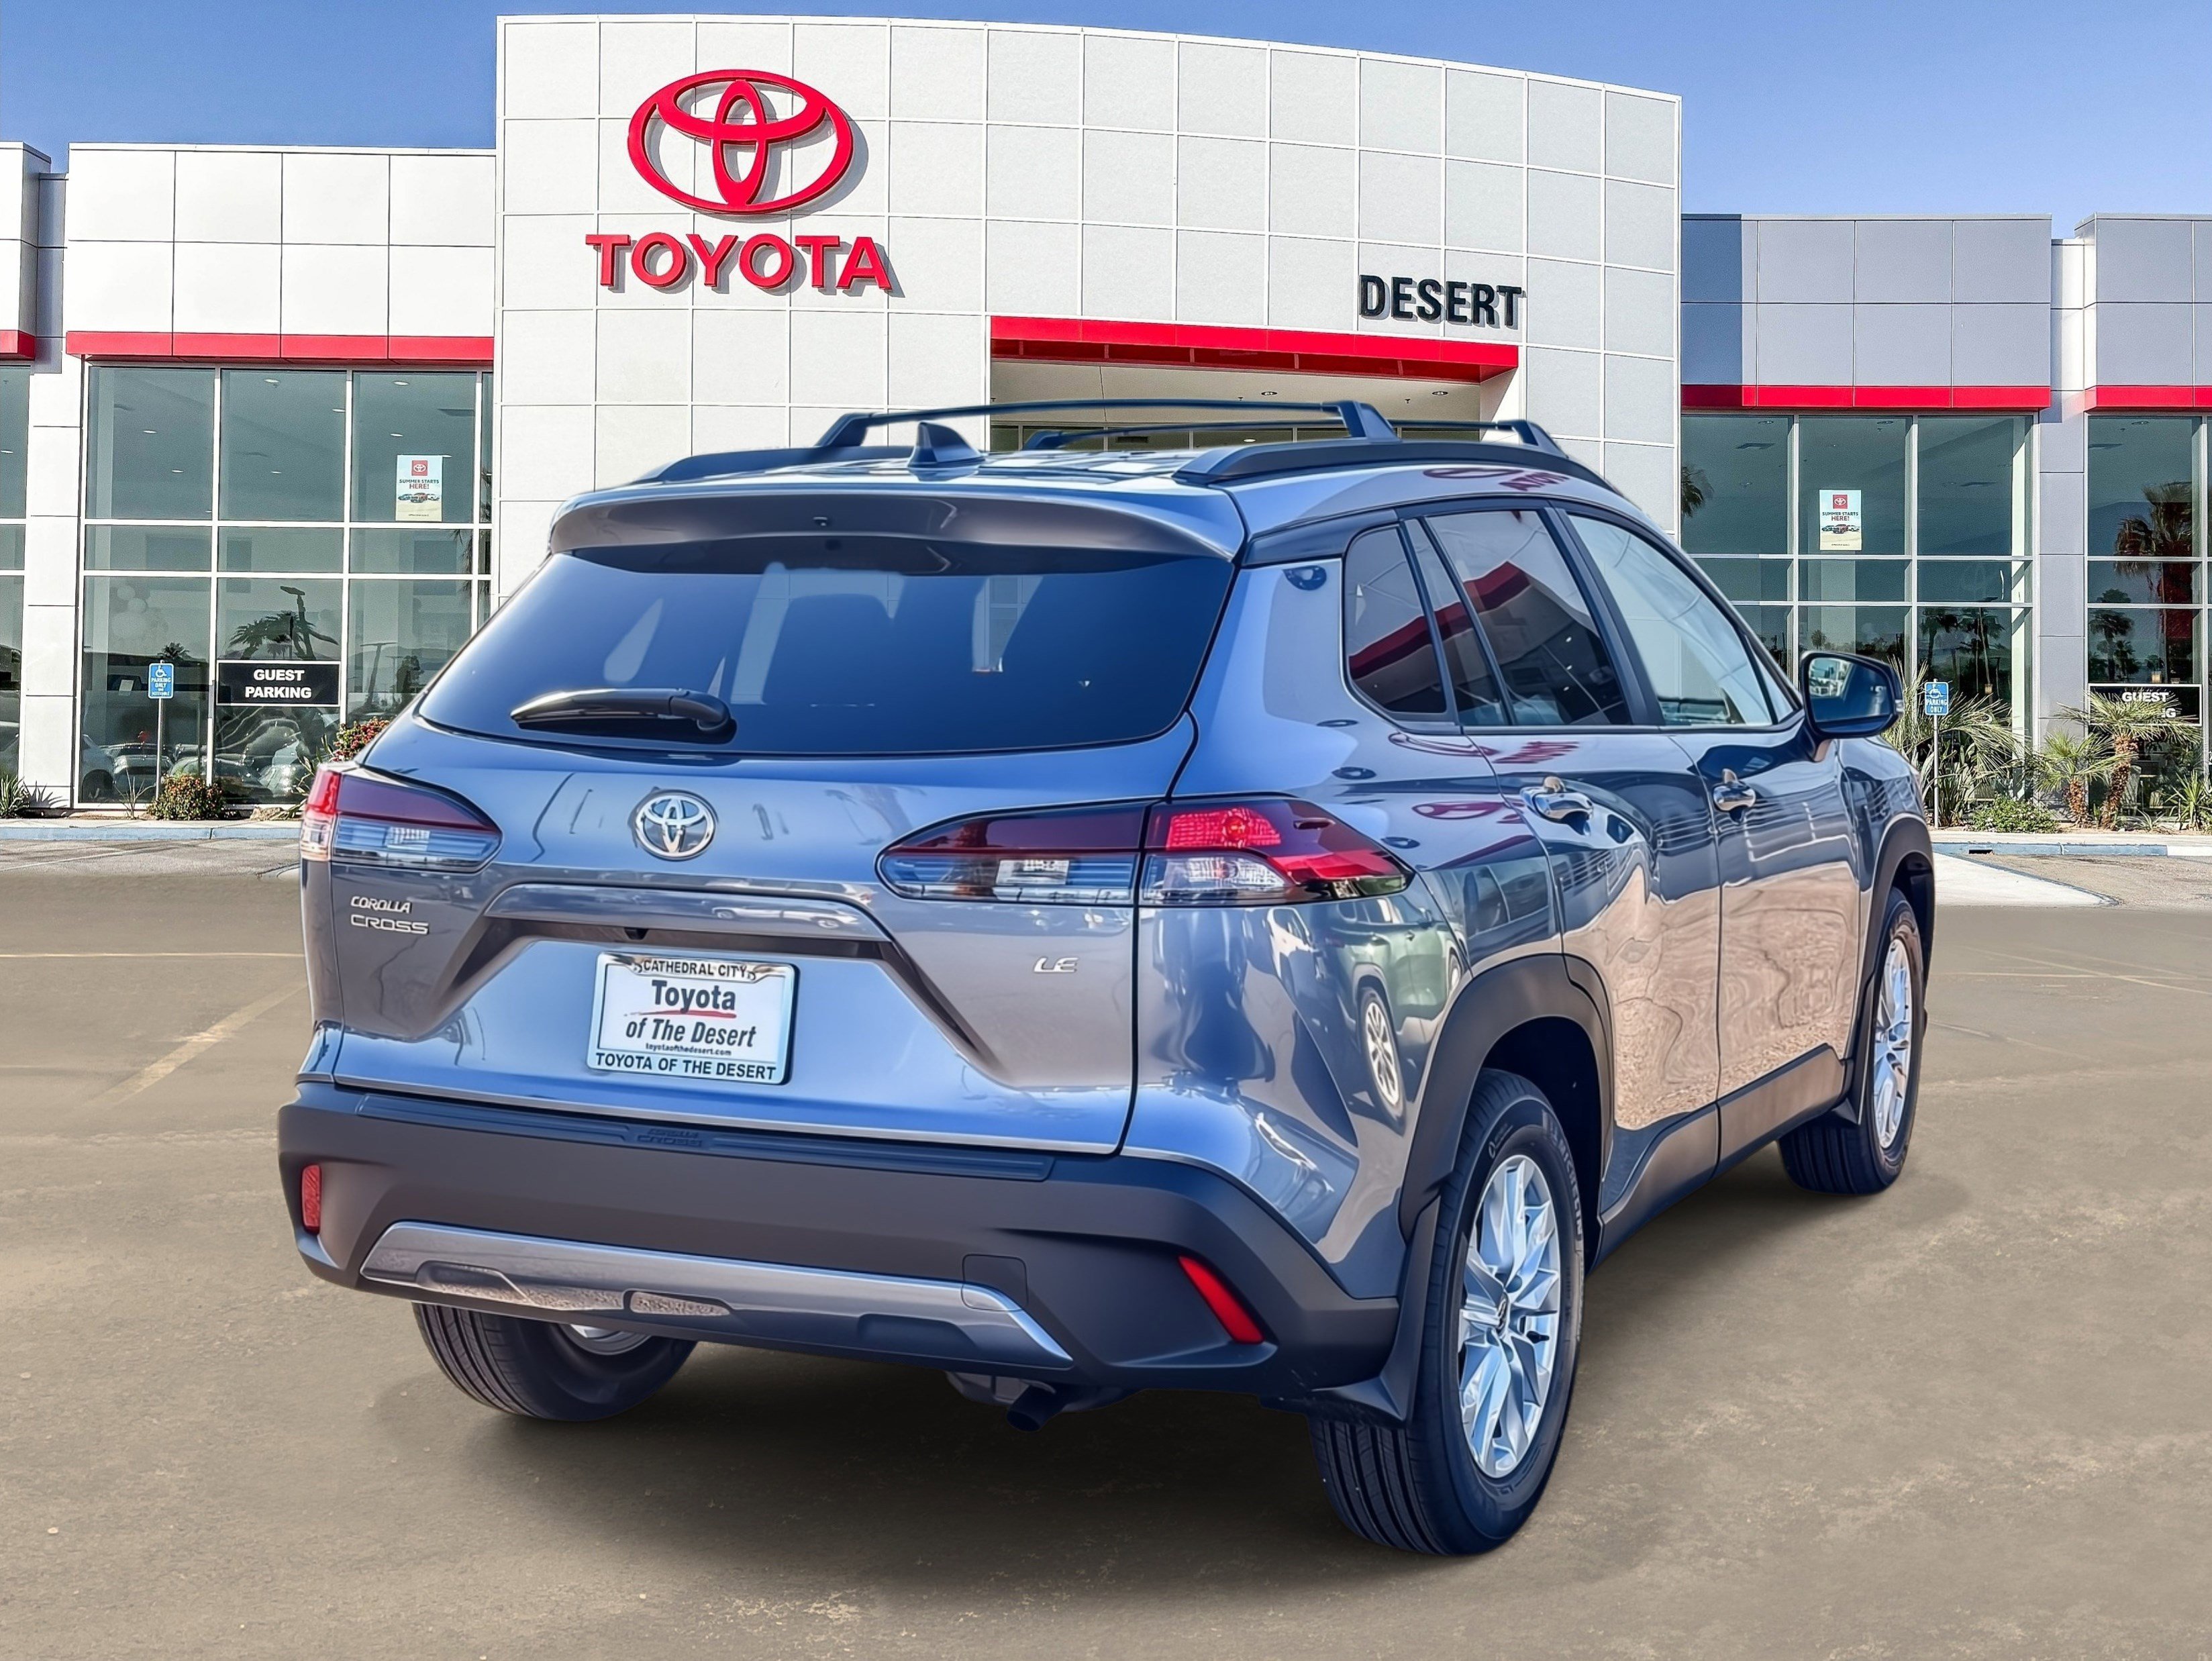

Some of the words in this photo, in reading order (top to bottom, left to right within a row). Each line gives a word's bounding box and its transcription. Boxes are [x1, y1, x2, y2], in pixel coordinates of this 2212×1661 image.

[585, 232, 893, 290] TOYOTA
[1359, 274, 1522, 326] DESERT
[253, 669, 305, 681] GUEST
[245, 686, 311, 699] PARKING
[2121, 692, 2170, 703] GUEST
[350, 896, 411, 913] COROLLA
[350, 914, 430, 935] CROSS
[643, 959, 714, 976] CATHEDRAL
[717, 966, 747, 978] CITY
[1034, 956, 1079, 973] LE
[652, 980, 736, 1014] Toyota
[625, 1018, 648, 1038] of
[652, 1018, 686, 1041] The
[691, 1021, 756, 1048] Desert
[645, 1042, 732, 1056] toyotaofthedesert.com
[596, 1052, 652, 1070] TOYOTA
[658, 1058, 678, 1072] OF
[683, 1060, 712, 1074] THE
[715, 1063, 776, 1080] DESERT
